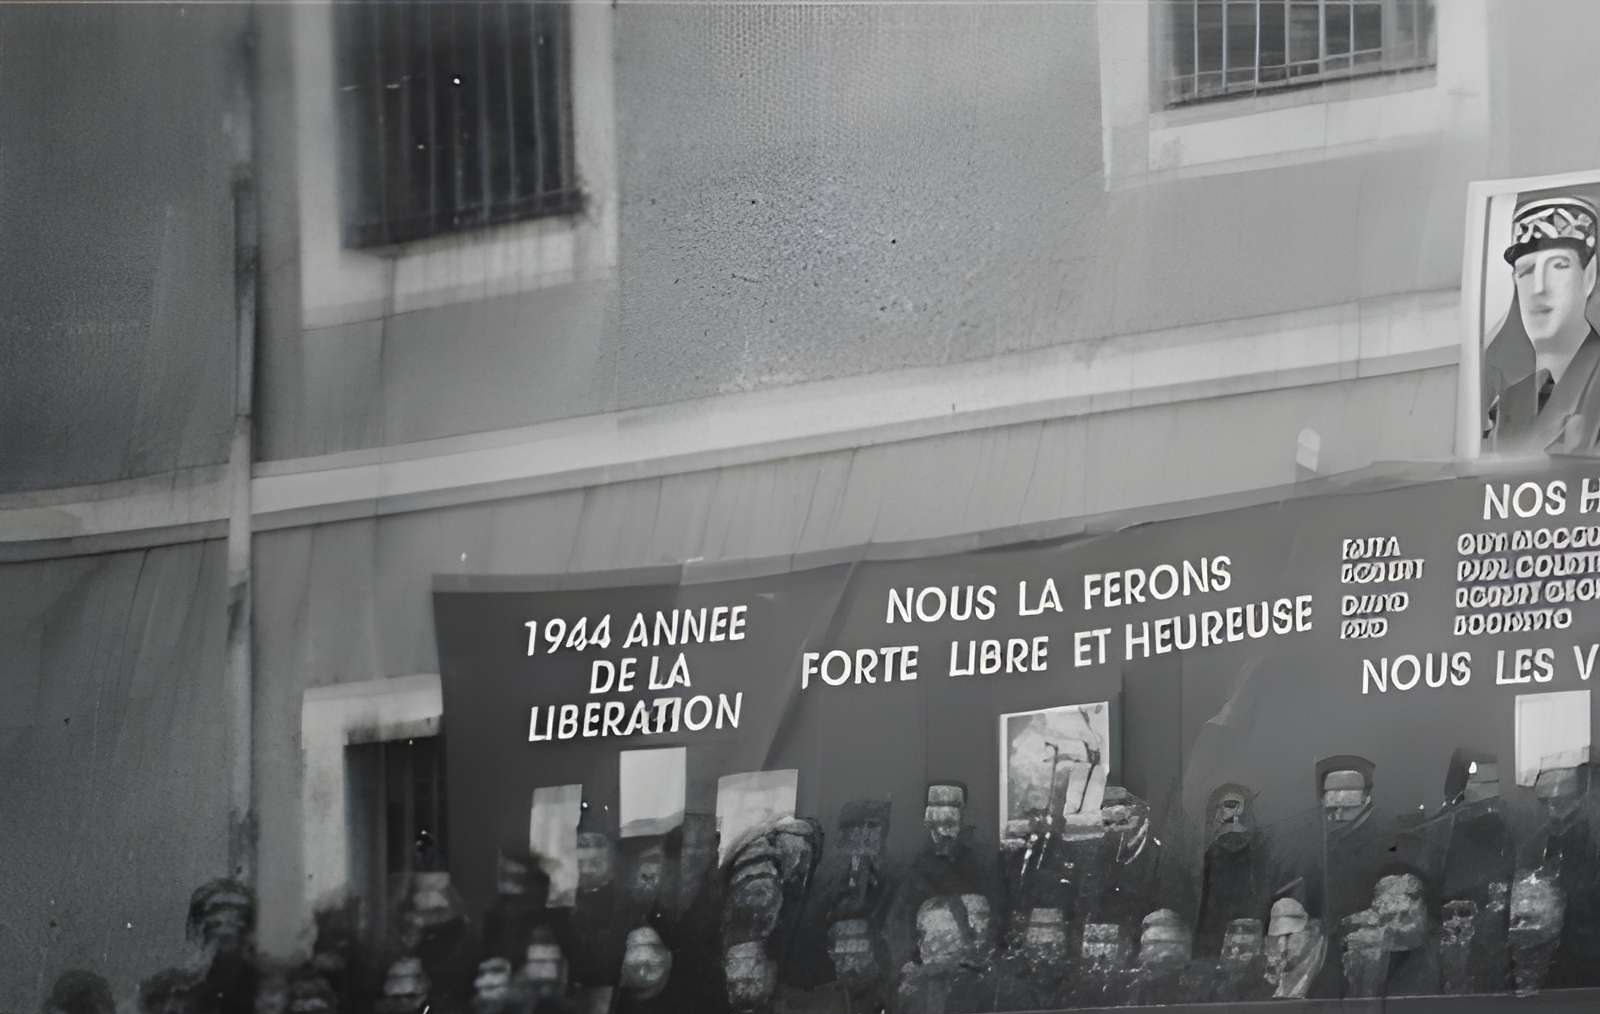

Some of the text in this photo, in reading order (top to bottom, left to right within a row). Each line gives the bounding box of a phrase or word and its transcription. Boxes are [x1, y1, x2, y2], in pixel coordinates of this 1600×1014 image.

[1483, 480, 1567, 521] NOS
[886, 555, 1232, 624] NOUS LA FERONS
[523, 604, 748, 657] 1944 ANNEE
[801, 645, 919, 690] FORTE
[949, 635, 1049, 677] LIBRE
[1073, 627, 1110, 668] ET
[1124, 594, 1313, 661] HEUREUSE
[589, 652, 692, 694] DE LA
[1362, 651, 1472, 695] NOUS
[1495, 647, 1555, 685] LES
[528, 691, 743, 742] LIBERATION
